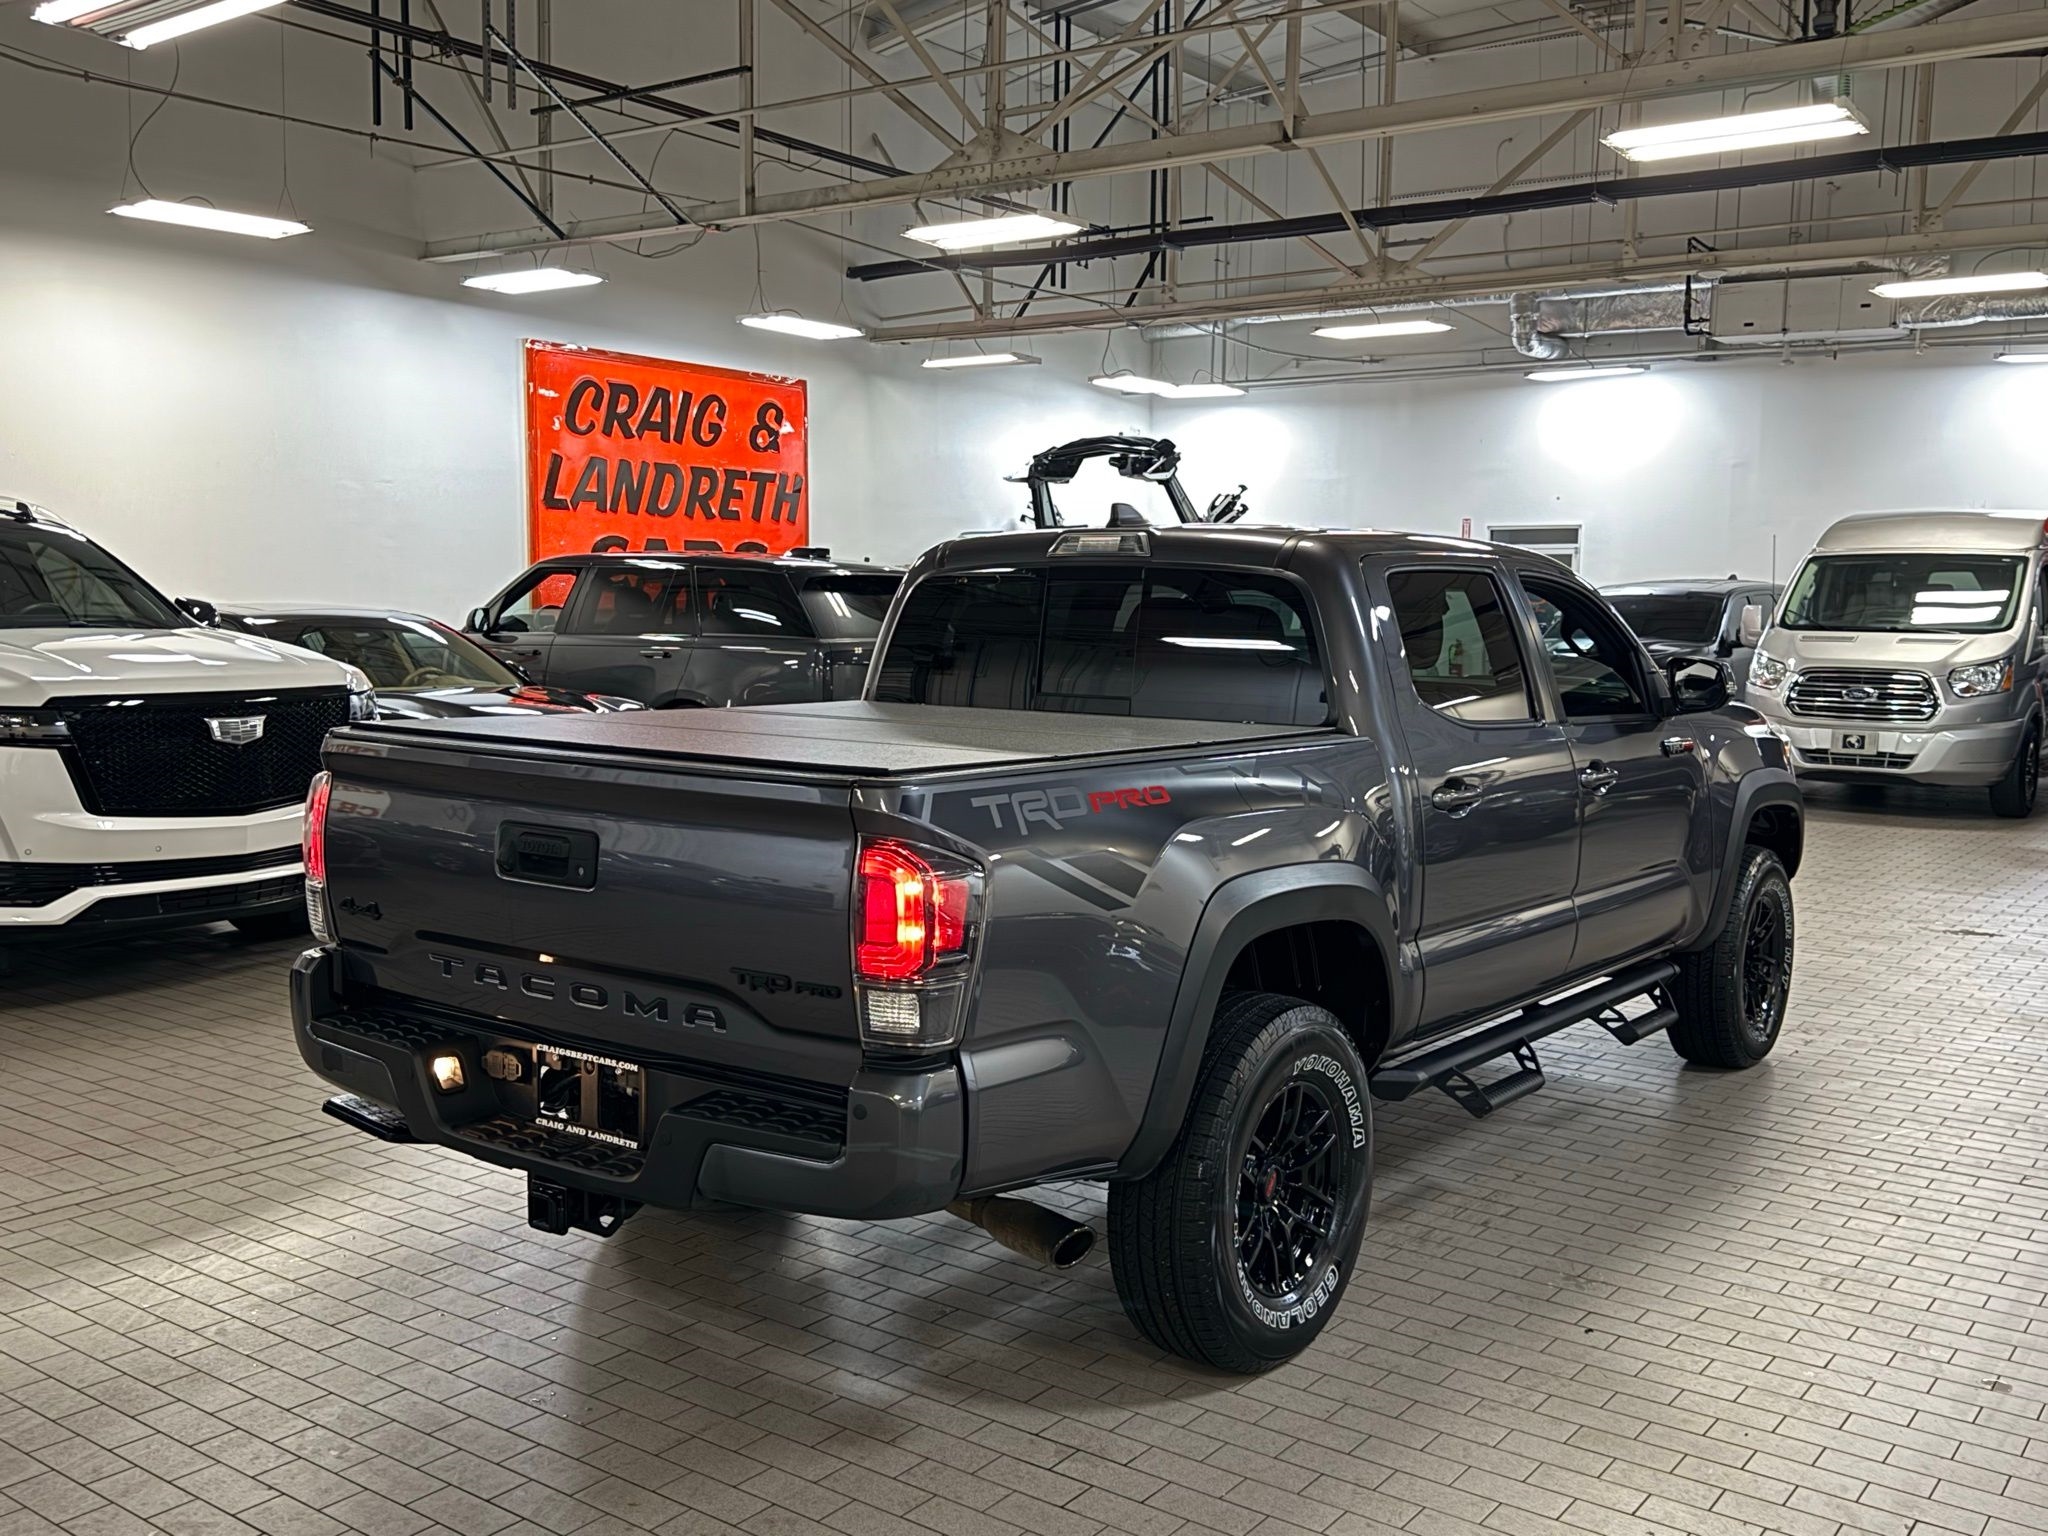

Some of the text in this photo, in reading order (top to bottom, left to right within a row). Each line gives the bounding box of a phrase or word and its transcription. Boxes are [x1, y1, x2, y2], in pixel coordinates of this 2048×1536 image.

[564, 378, 784, 453] CRAIG &
[543, 452, 803, 525] LANDRETH
[970, 785, 1172, 836] TRD PRO
[428, 953, 727, 1034] TACOMA
[729, 966, 843, 999] TRD PRO
[536, 1043, 639, 1073] CRAIGSBESTCARS.COM
[1292, 1053, 1366, 1149] YOKOHAMA
[535, 1117, 639, 1150] CRAIG AND LANDRETH
